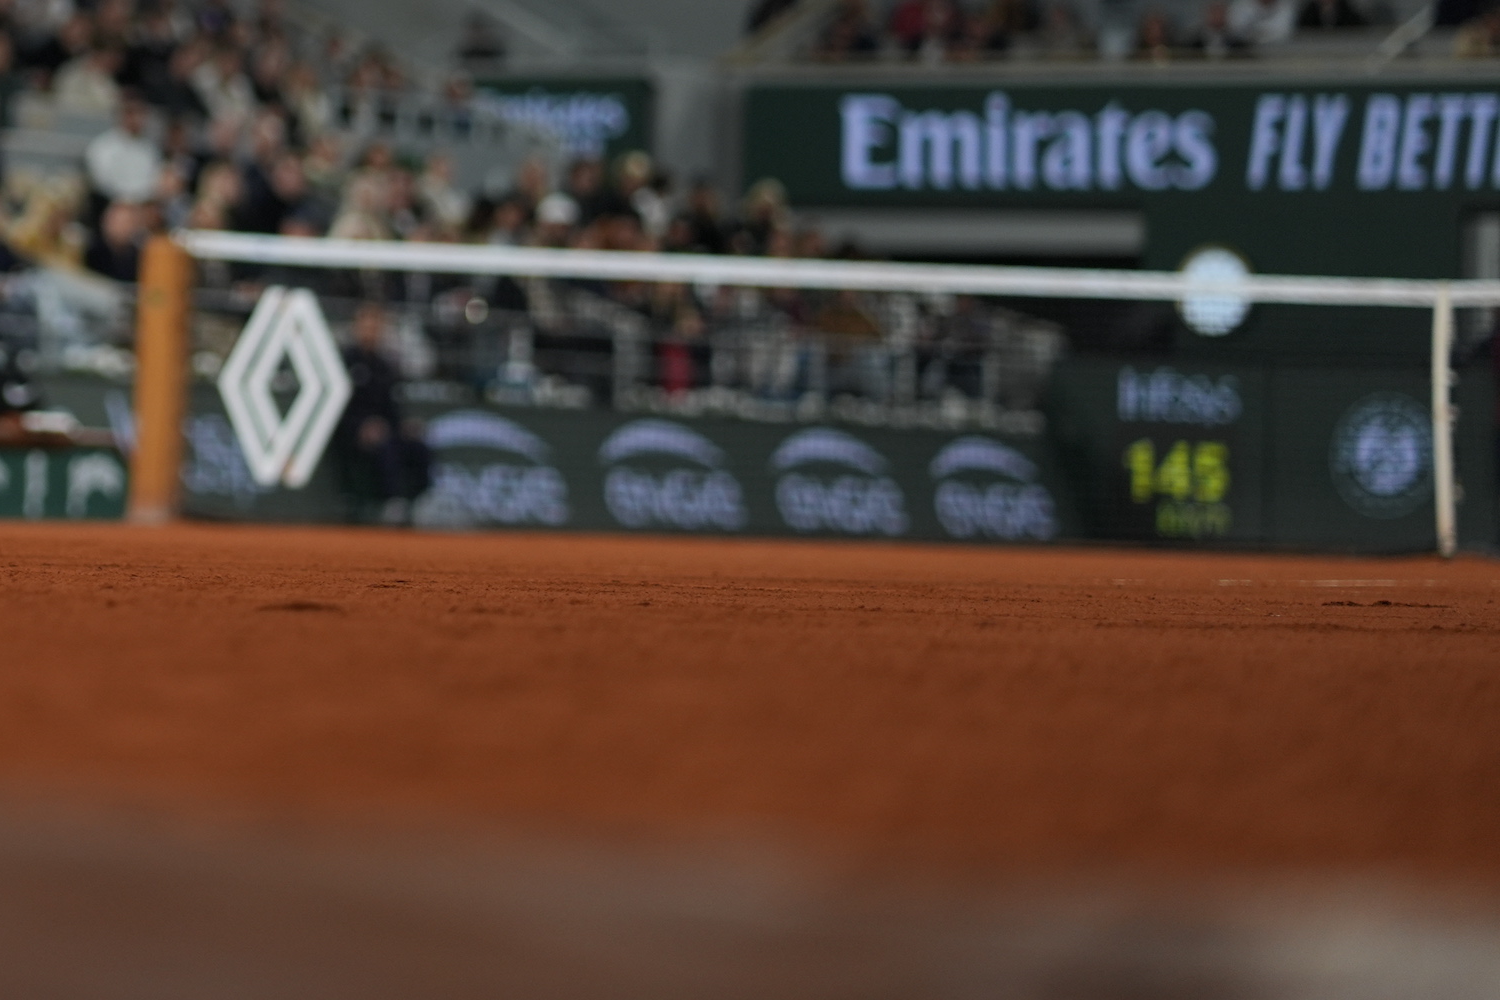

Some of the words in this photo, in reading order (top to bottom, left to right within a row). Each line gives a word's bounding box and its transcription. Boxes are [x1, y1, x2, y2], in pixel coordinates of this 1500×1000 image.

[839, 91, 1218, 191] Emirates
[1247, 92, 1350, 191] FLY
[1355, 92, 1500, 191] BETT
[1123, 437, 1231, 503] 145
